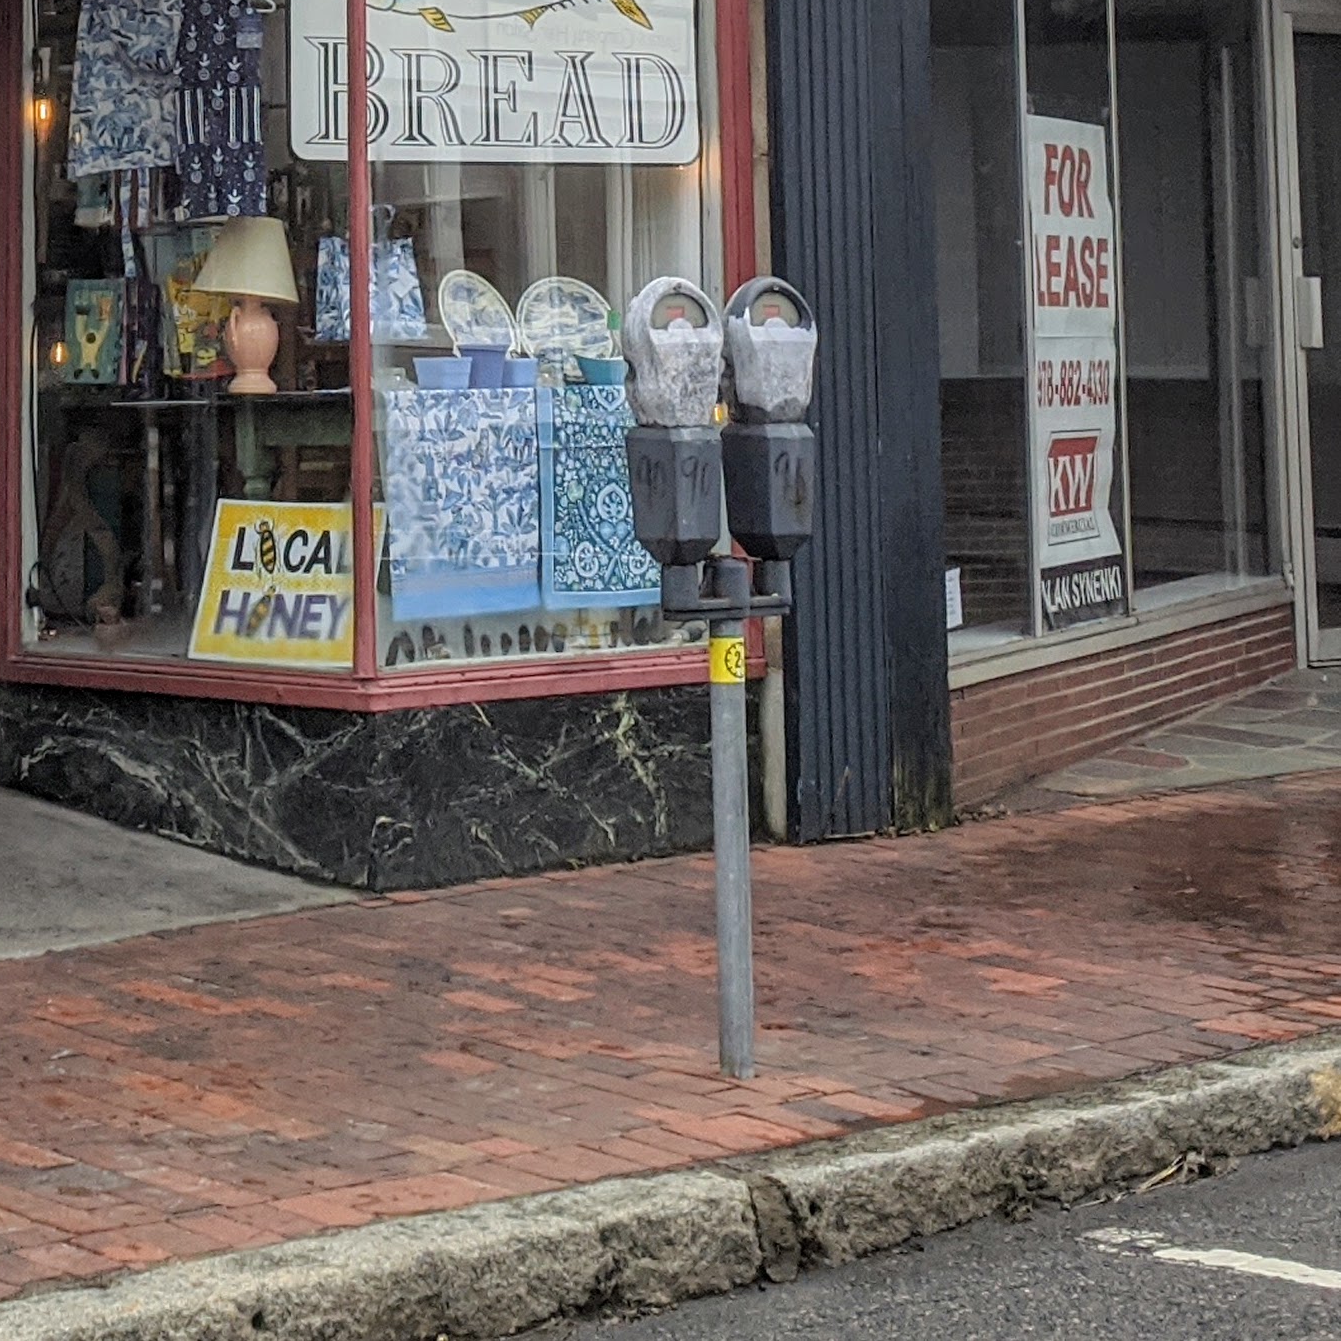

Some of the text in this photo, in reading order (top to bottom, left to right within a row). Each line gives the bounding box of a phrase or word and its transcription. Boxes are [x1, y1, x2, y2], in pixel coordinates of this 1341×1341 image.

[304, 36, 687, 148] BREAD
[1044, 143, 1094, 219] FOR
[1035, 234, 1109, 308] LEASE
[1048, 452, 1093, 513] KW
[231, 518, 352, 575] LOCAL
[212, 585, 351, 641] HONEY
